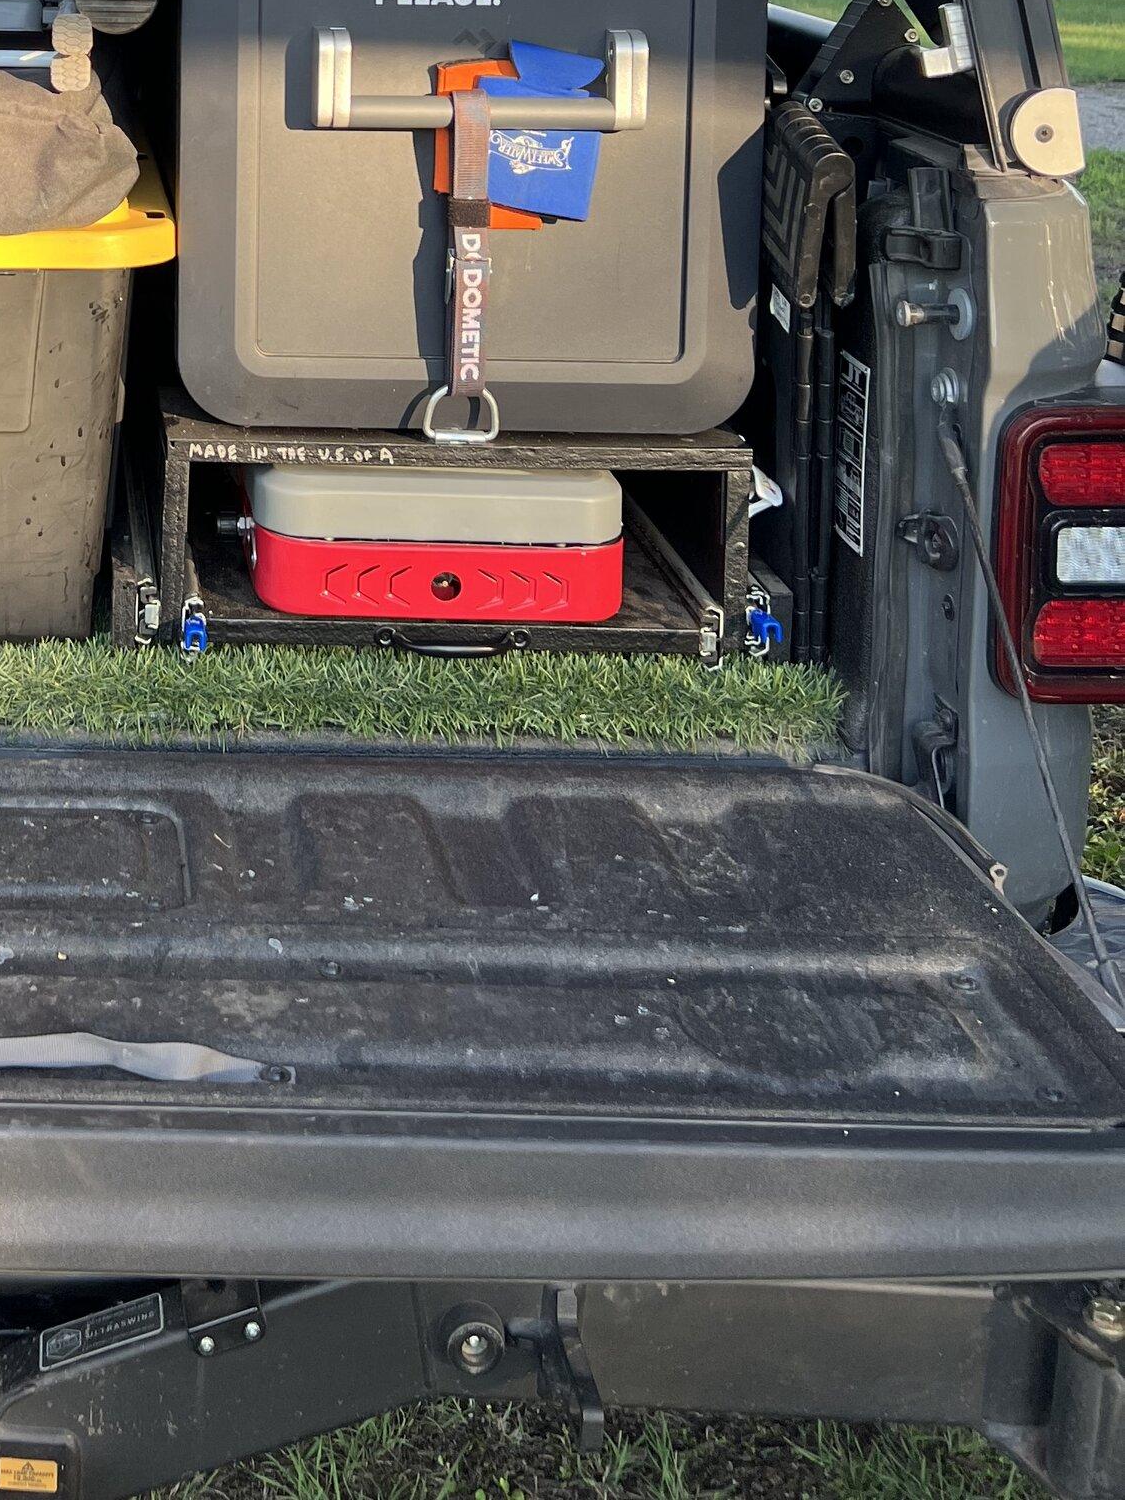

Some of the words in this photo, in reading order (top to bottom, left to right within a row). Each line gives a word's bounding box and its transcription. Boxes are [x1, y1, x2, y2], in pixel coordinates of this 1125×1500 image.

[459, 268, 483, 381] DOMETIC
[189, 443, 237, 460] MADE
[250, 446, 269, 459] IN
[277, 446, 305, 461] THE
[380, 447, 394, 465] A
